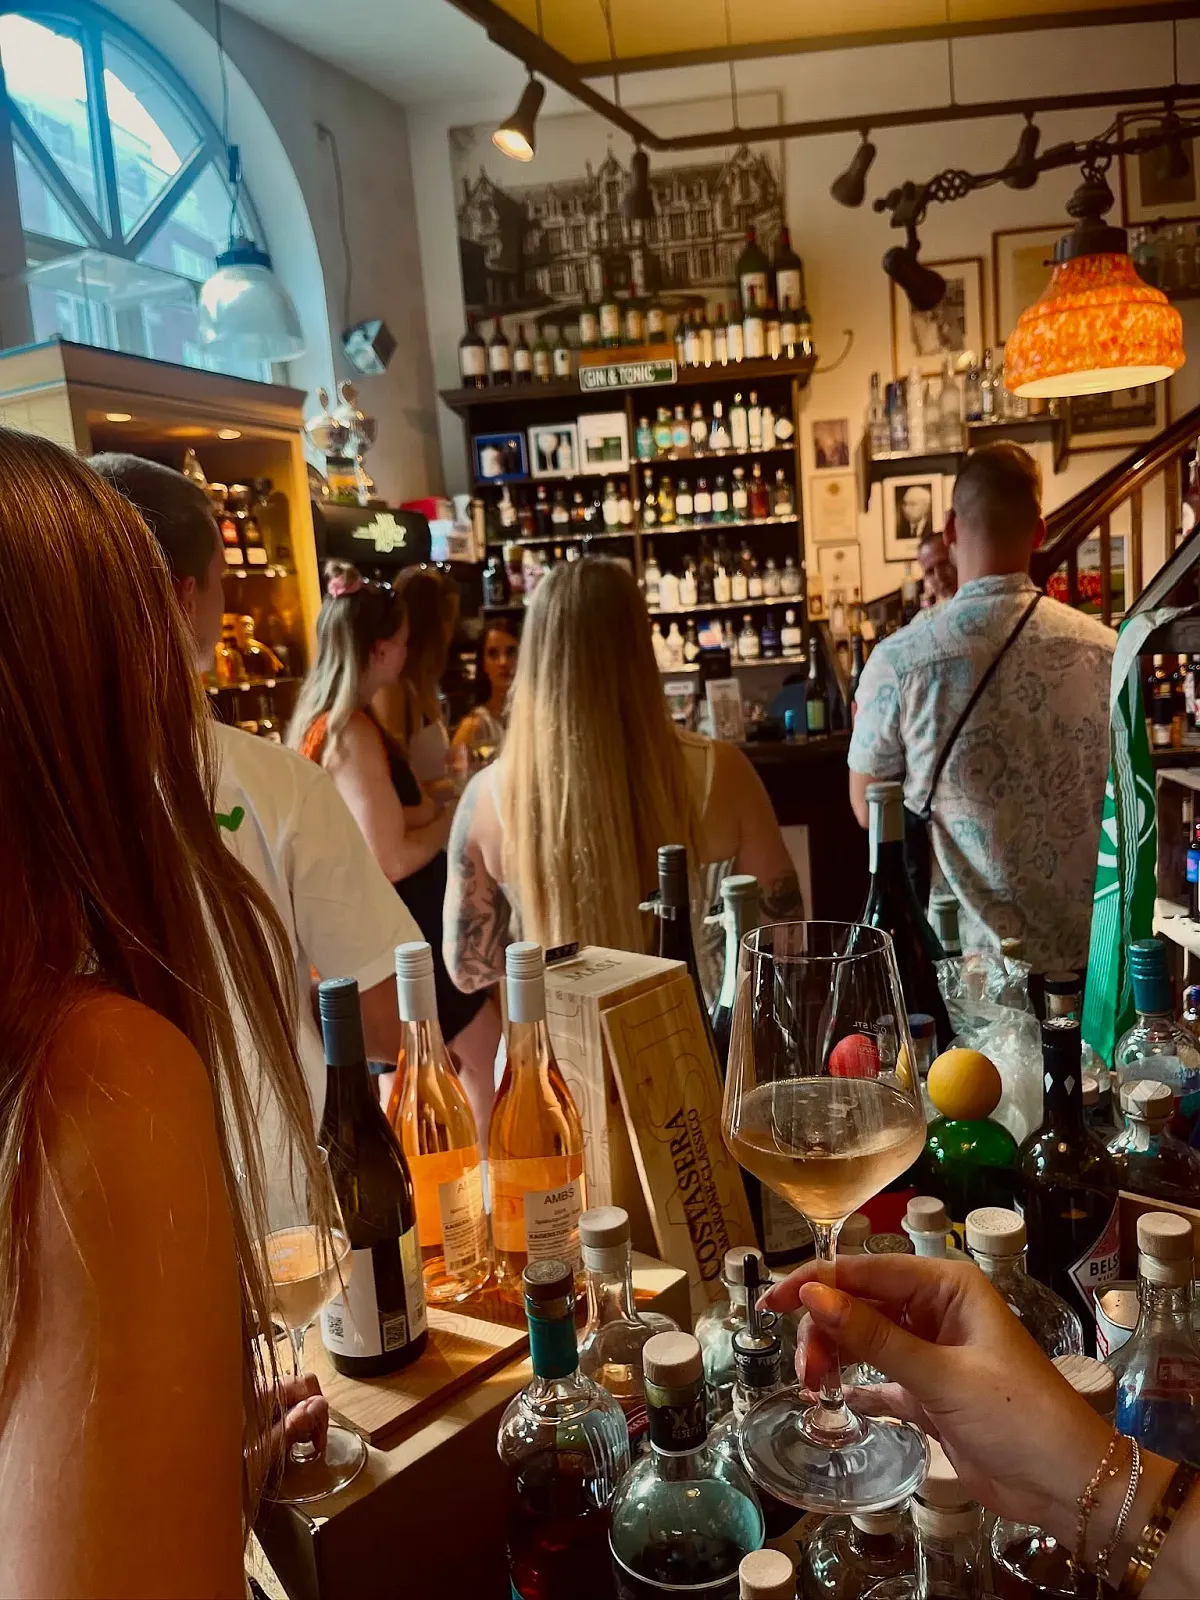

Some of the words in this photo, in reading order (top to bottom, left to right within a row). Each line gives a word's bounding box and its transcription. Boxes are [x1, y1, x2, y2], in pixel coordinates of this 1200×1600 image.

[585, 368, 606, 388] GIN
[619, 365, 656, 385] TONIC
[565, 959, 622, 981] MASI
[543, 1187, 575, 1205] AMBS
[664, 1107, 721, 1282] COSTASERA
